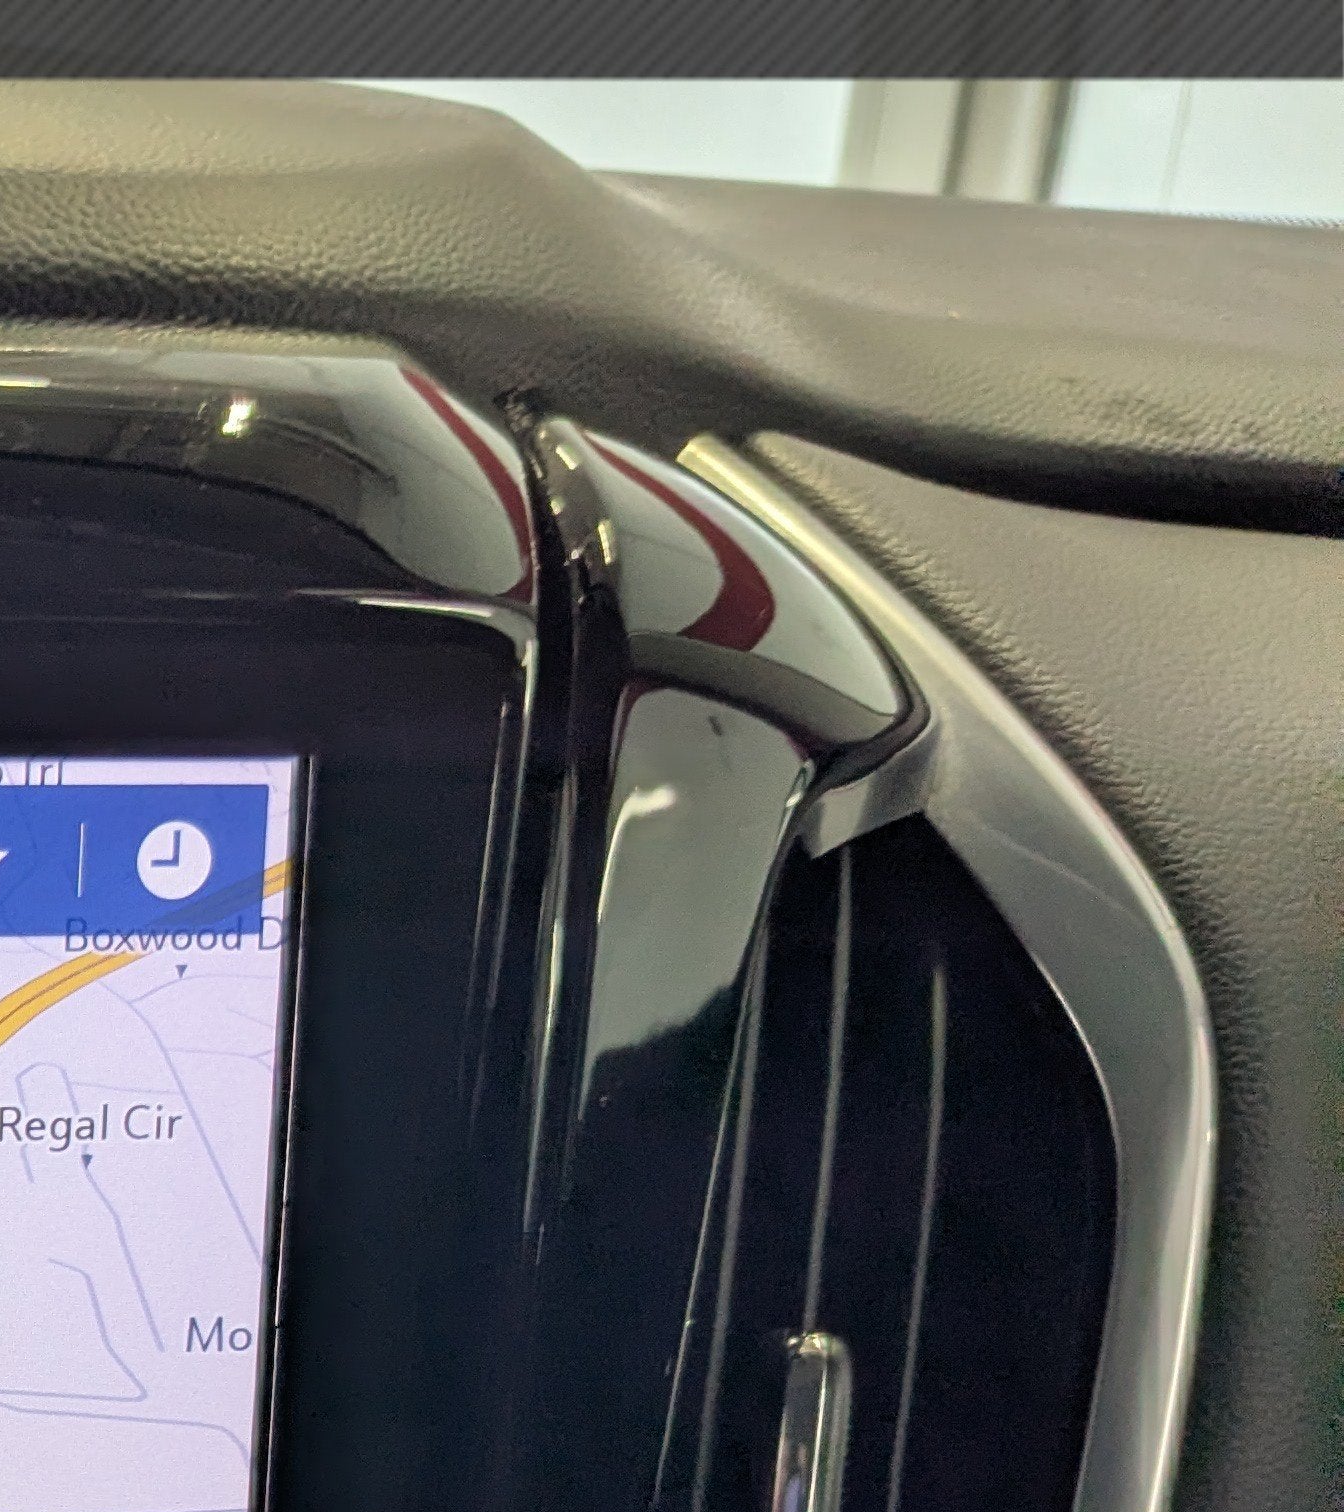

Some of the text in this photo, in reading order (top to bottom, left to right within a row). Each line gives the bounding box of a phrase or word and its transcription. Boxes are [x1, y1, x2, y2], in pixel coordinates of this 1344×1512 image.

[65, 916, 243, 952] Boxwood
[124, 1104, 182, 1140] Cir
[188, 1316, 252, 1352] Mo
